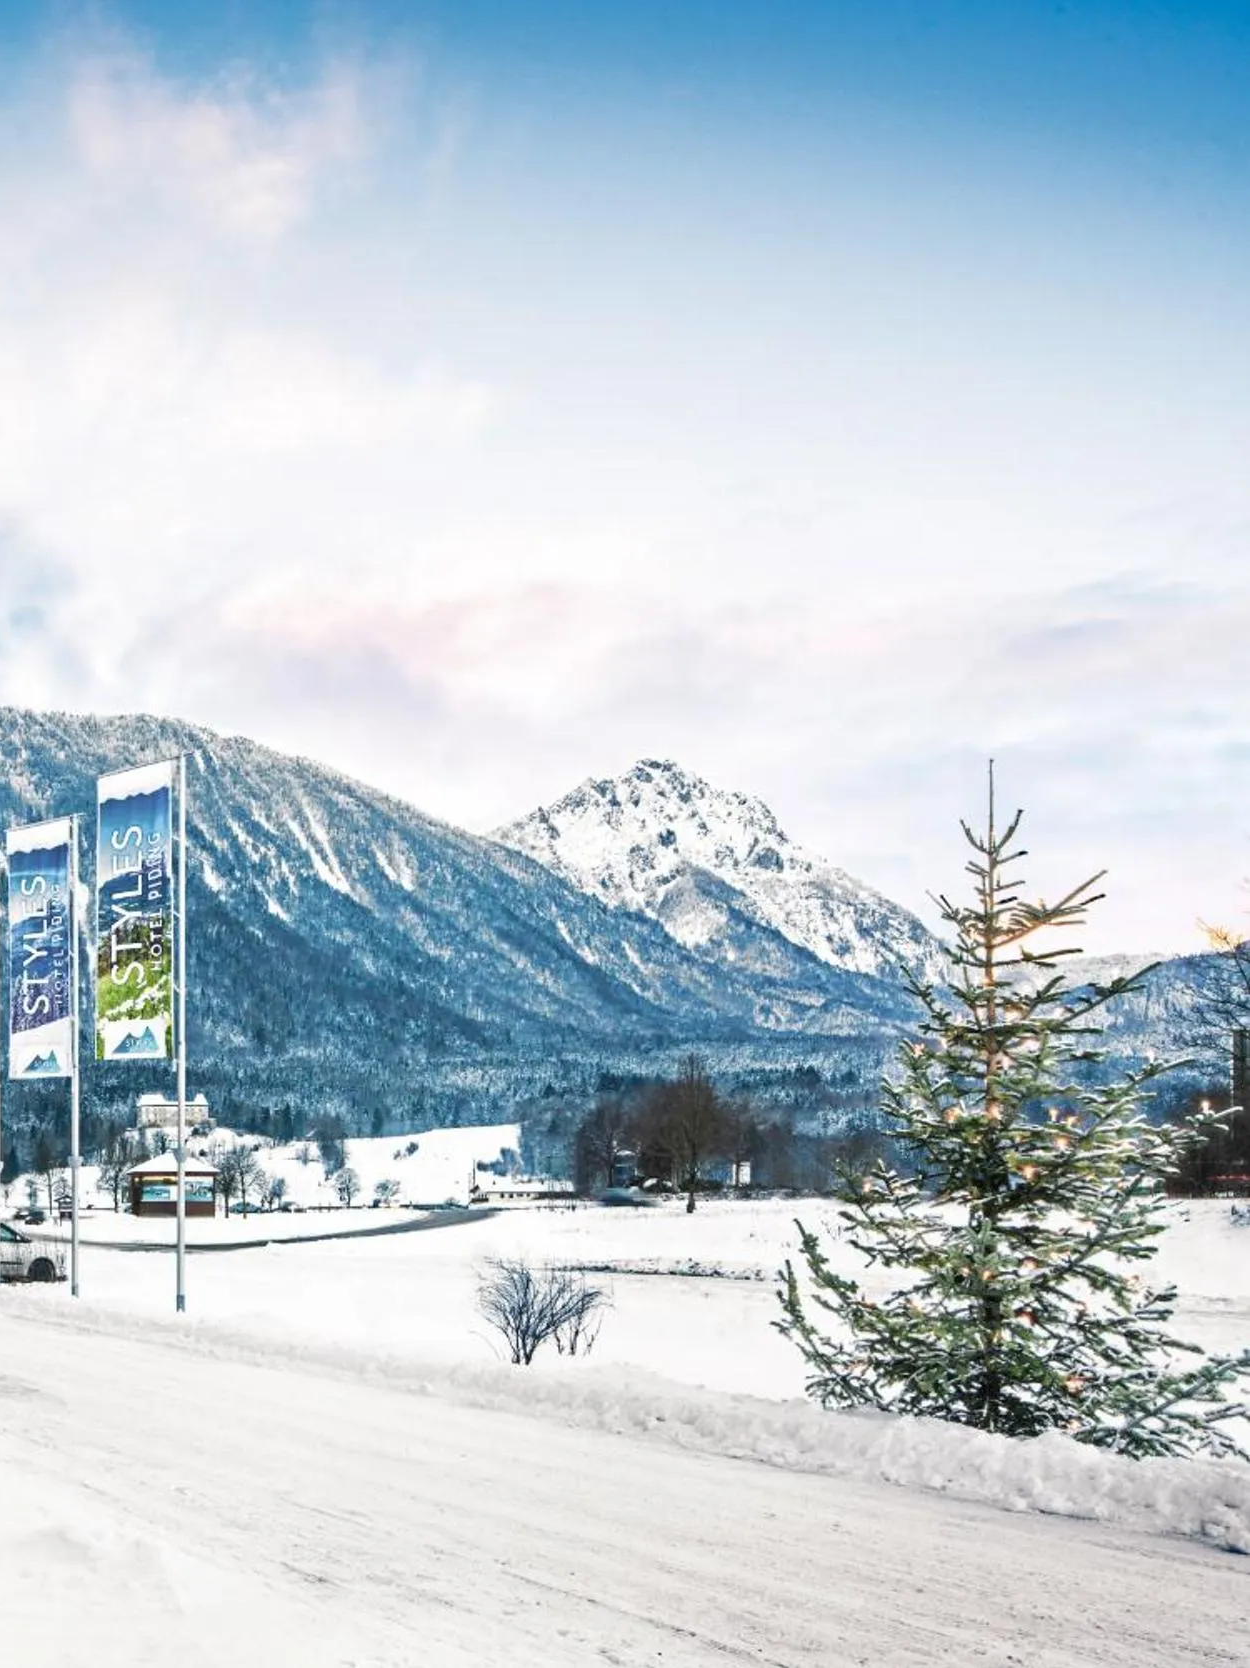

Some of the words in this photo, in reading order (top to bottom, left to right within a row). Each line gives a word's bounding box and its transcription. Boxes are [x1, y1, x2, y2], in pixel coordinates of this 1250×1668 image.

[147, 832, 163, 901] PIDING
[111, 825, 145, 987] STYLES
[150, 907, 163, 971] HOTEL
[21, 876, 50, 1015] STYLES
[52, 949, 65, 1006] HOTEL
